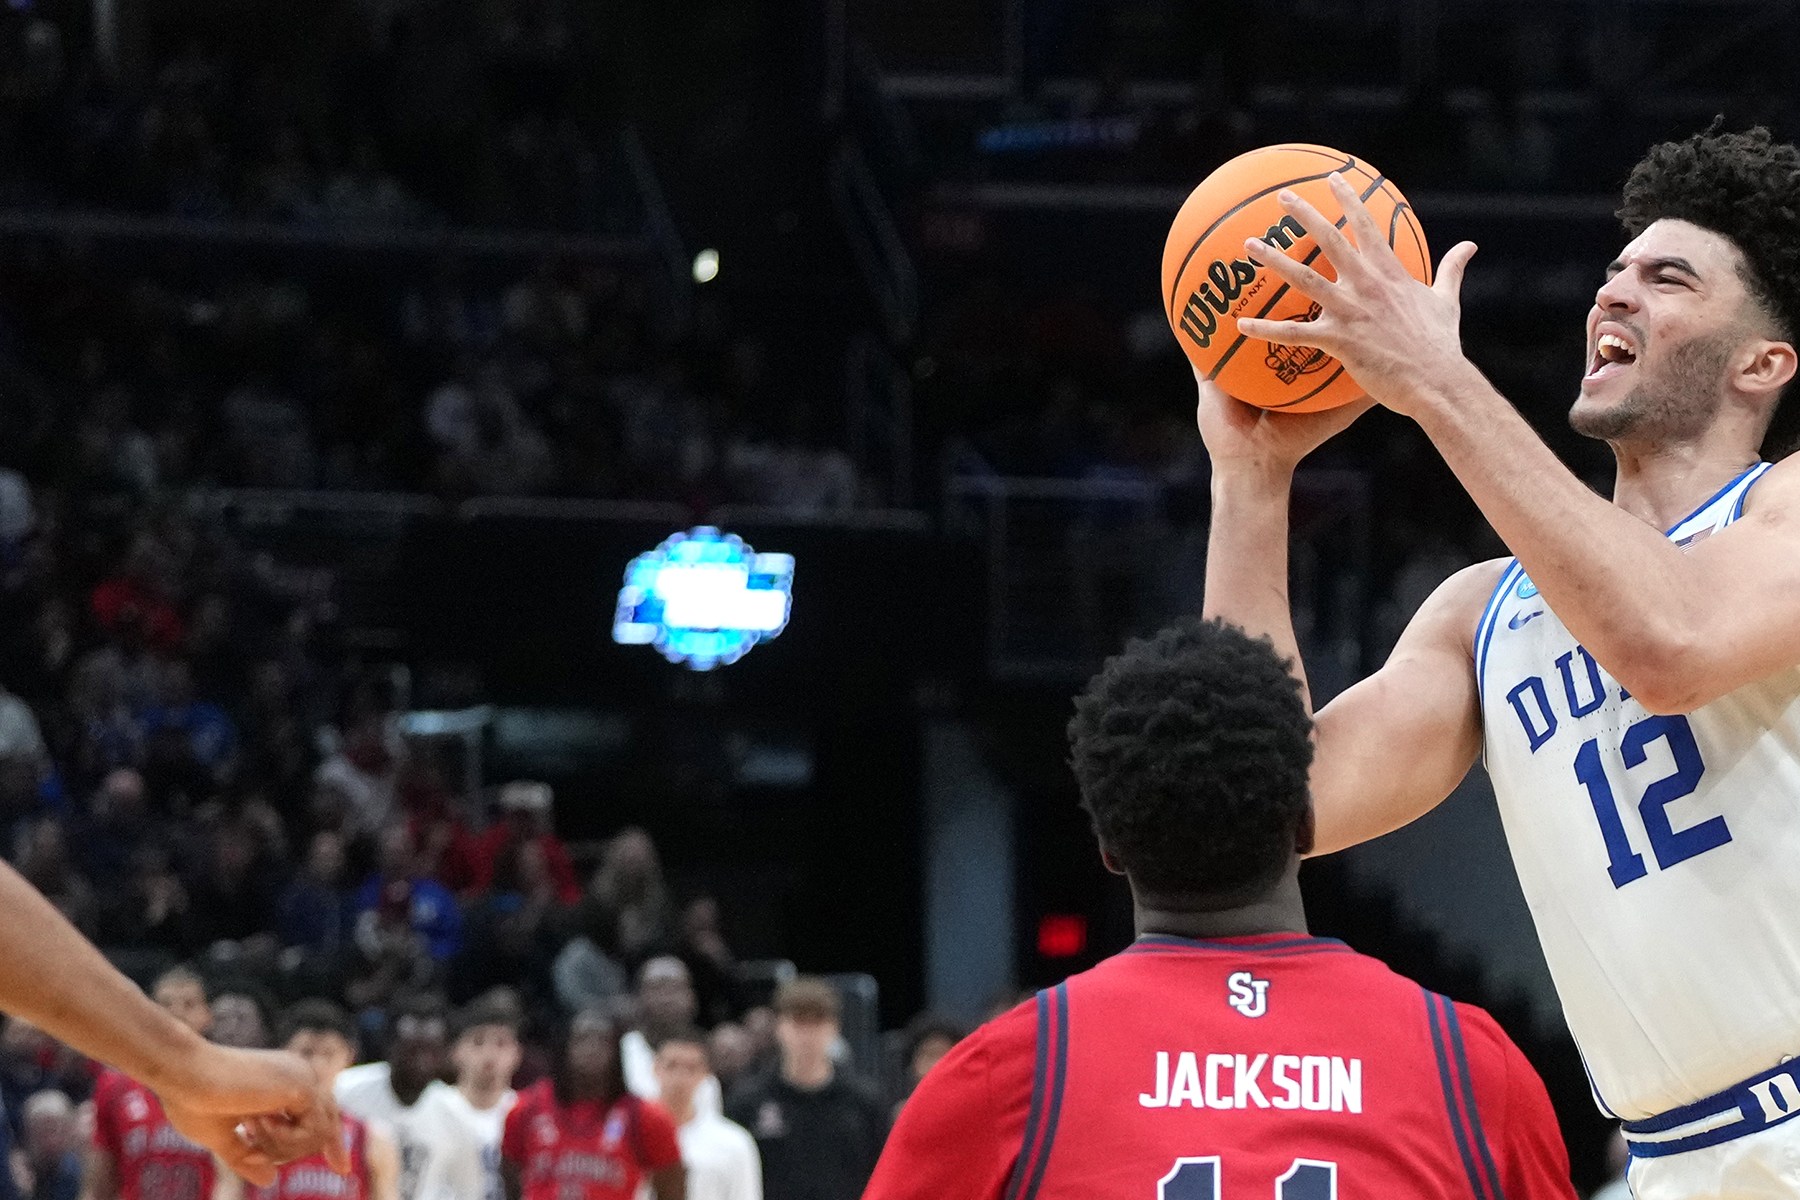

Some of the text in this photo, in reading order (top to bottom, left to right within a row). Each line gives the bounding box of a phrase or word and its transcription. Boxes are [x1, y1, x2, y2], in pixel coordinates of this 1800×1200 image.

[1231, 275, 1268, 319] EVO NXT
[1506, 644, 1633, 754] DU
[1573, 713, 1733, 890] 12
[1227, 971, 1270, 1018] SJ
[1138, 1051, 1363, 1114] JACKSON
